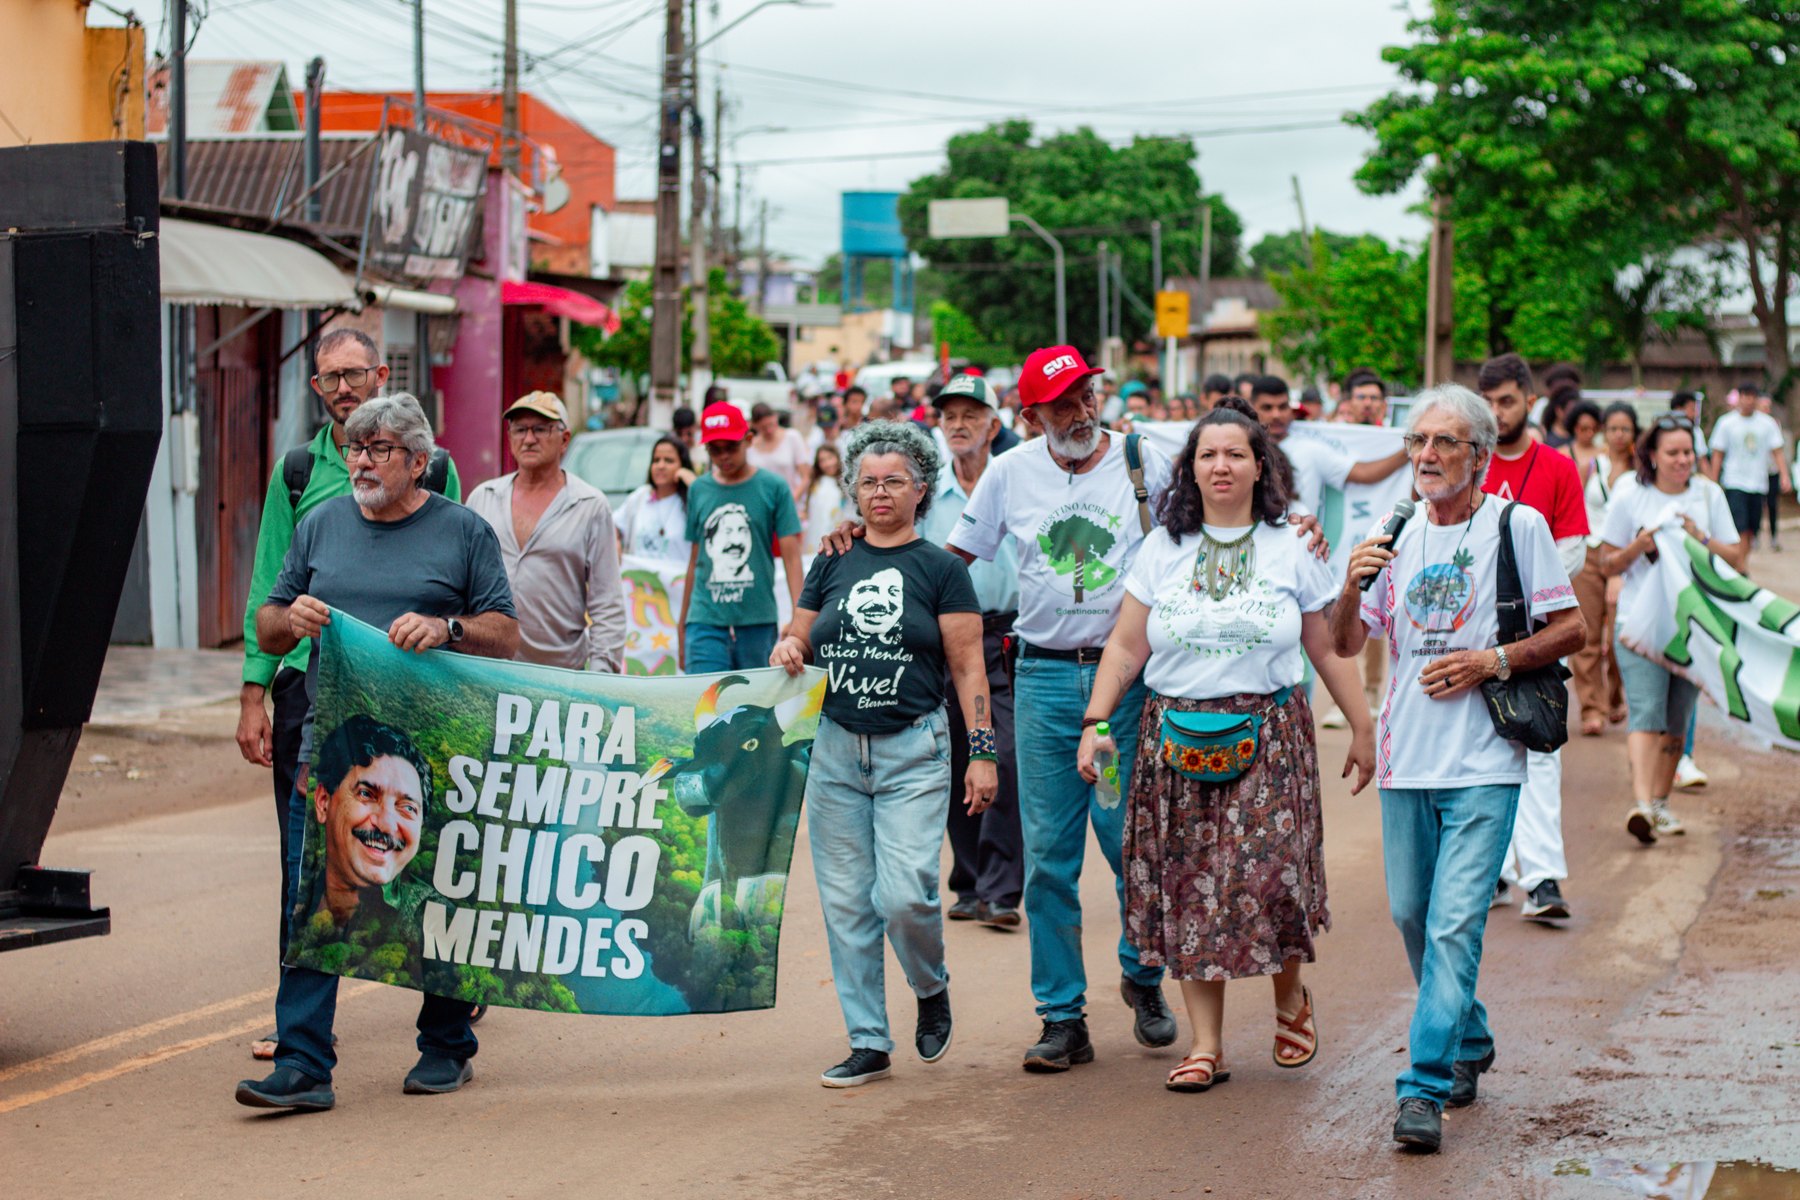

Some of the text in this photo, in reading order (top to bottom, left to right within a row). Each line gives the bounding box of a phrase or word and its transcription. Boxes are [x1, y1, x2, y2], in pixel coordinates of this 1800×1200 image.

[1042, 355, 1073, 376] CUT
[1038, 502, 1108, 533] DESTINO ACRE
[1055, 607, 1110, 617] @destinoacre
[820, 644, 913, 662] Chico Mendes
[828, 661, 905, 696] Vive!
[493, 692, 636, 765] PARA
[445, 754, 668, 830] SEMPRE
[432, 819, 661, 911] CHICO
[422, 900, 649, 980] MENDES
